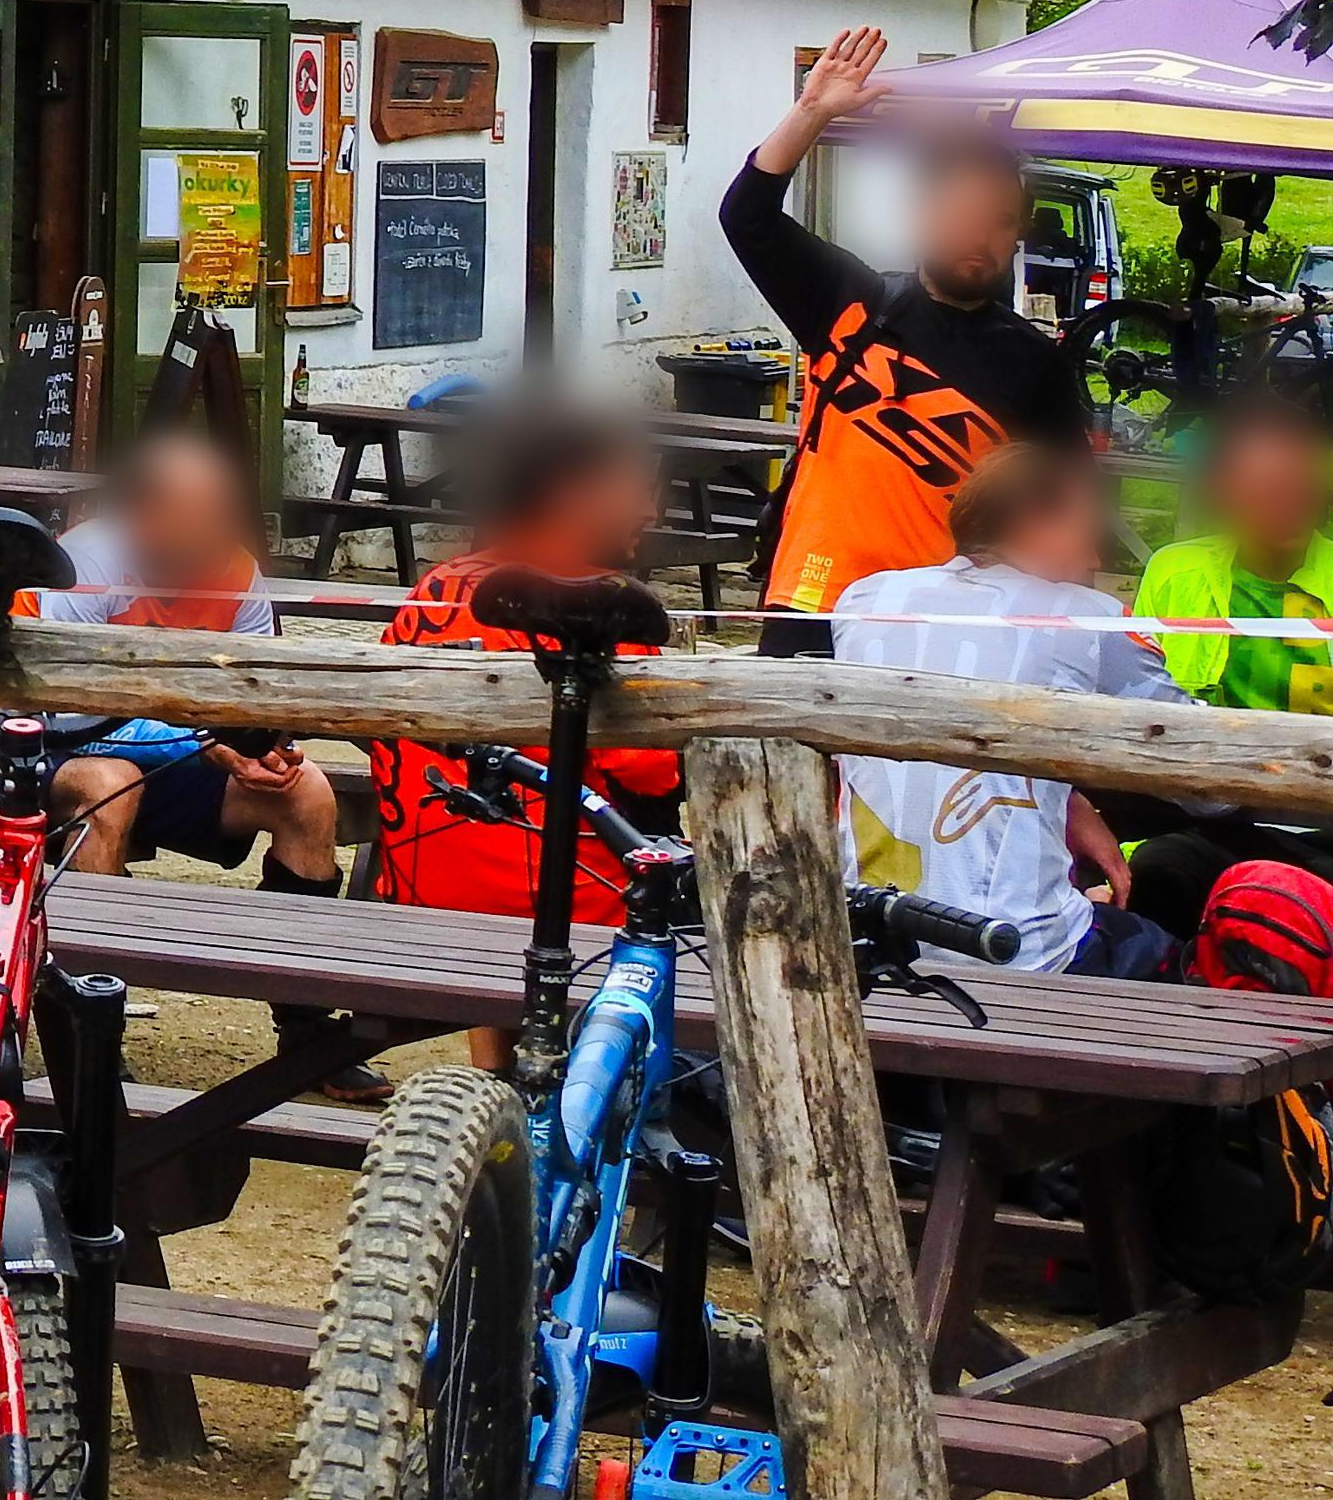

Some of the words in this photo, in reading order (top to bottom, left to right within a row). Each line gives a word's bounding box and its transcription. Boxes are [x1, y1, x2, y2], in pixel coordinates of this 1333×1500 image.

[183, 171, 251, 199] okurky
[806, 553, 833, 568] TWO
[800, 568, 829, 583] ONE
